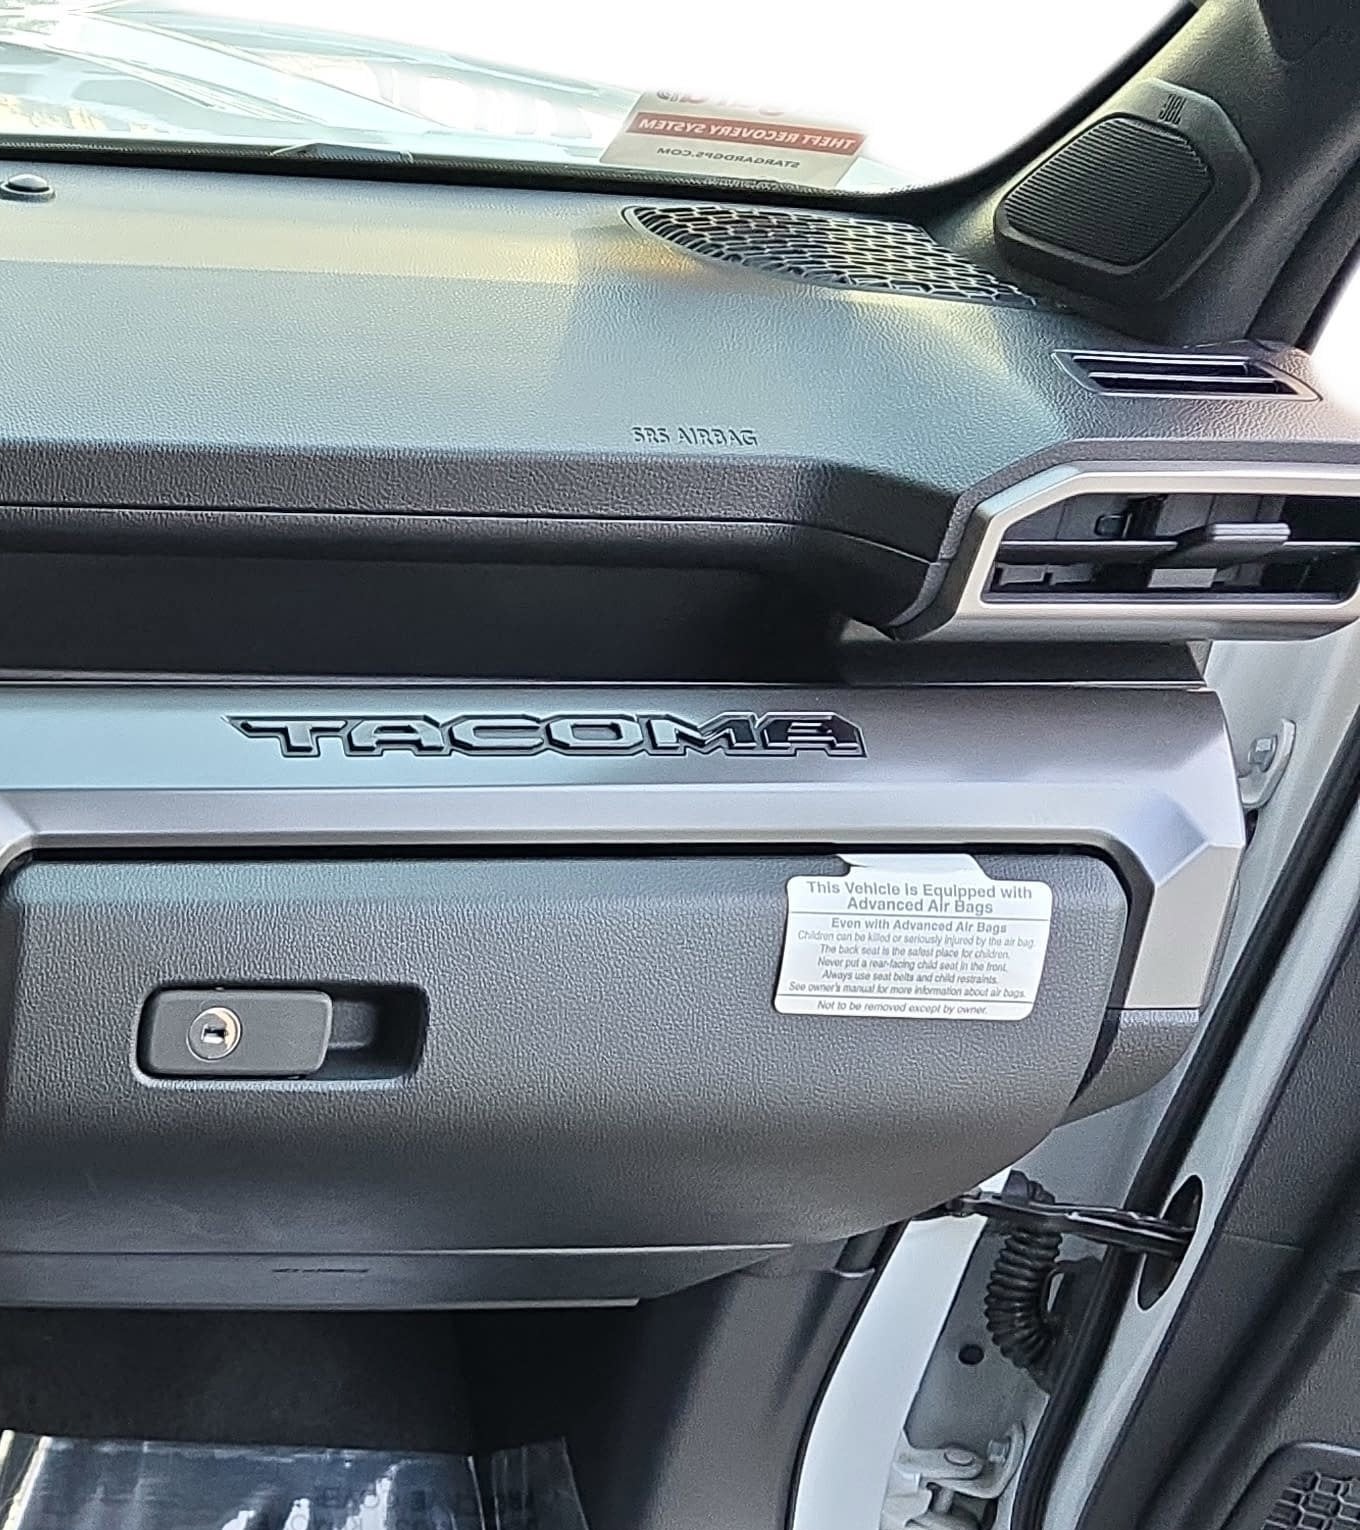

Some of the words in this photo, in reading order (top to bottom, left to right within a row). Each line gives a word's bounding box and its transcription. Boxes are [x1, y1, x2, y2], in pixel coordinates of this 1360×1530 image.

[632, 426, 670, 444] SRS
[678, 427, 758, 446] AIRBAG
[222, 713, 868, 758] TACOMA
[806, 881, 841, 894] This
[844, 882, 901, 896] Vehicle
[905, 883, 918, 896] is
[923, 884, 996, 900] Equipped
[1001, 886, 1033, 899] with
[847, 896, 923, 912] Advanced
[928, 899, 951, 913] Air
[955, 900, 994, 916] Bags
[831, 917, 858, 929] Even
[864, 918, 890, 930] with
[893, 919, 953, 932] Advanced
[955, 921, 974, 933] Air
[977, 922, 1007, 935] Bags
[798, 929, 834, 941] Children
[836, 933, 852, 941] can
[855, 931, 866, 942] be
[892, 934, 902, 943] or
[904, 934, 943, 946] seriously
[944, 936, 974, 948] injured
[976, 936, 987, 947] by
[989, 937, 1002, 946] the
[1004, 938, 1016, 946] air
[820, 944, 837, 954] The
[838, 944, 858, 954] back
[861, 945, 880, 955] seat
[882, 946, 890, 955] is
[892, 946, 906, 956] the
[907, 947, 934, 957] safest
[935, 948, 959, 959] place
[961, 949, 972, 958] for
[817, 956, 844, 967] Never
[845, 958, 859, 969] put
[861, 960, 868, 968] a
[869, 959, 915, 971] rear-facing
[917, 960, 938, 970] child
[939, 961, 959, 971] seat
[960, 961, 968, 971] in
[970, 961, 984, 971] the
[822, 969, 853, 982] Always
[854, 972, 871, 981] use
[873, 972, 891, 981] seat
[893, 971, 914, 982] belts
[917, 973, 933, 982] and
[935, 973, 956, 983] child
[788, 981, 806, 992] See
[808, 982, 841, 993] owner's
[842, 983, 876, 993] manual
[877, 983, 888, 993] for
[890, 985, 912, 994] more
[914, 985, 962, 995] information
[964, 987, 989, 997] about
[990, 988, 1002, 997] air
[817, 1000, 835, 1010] Not
[837, 1001, 847, 1011] to
[849, 1000, 862, 1011] be
[864, 1002, 906, 1012] removed
[908, 1003, 941, 1014] except
[943, 1004, 955, 1015] by
[957, 1006, 988, 1015] owner.
